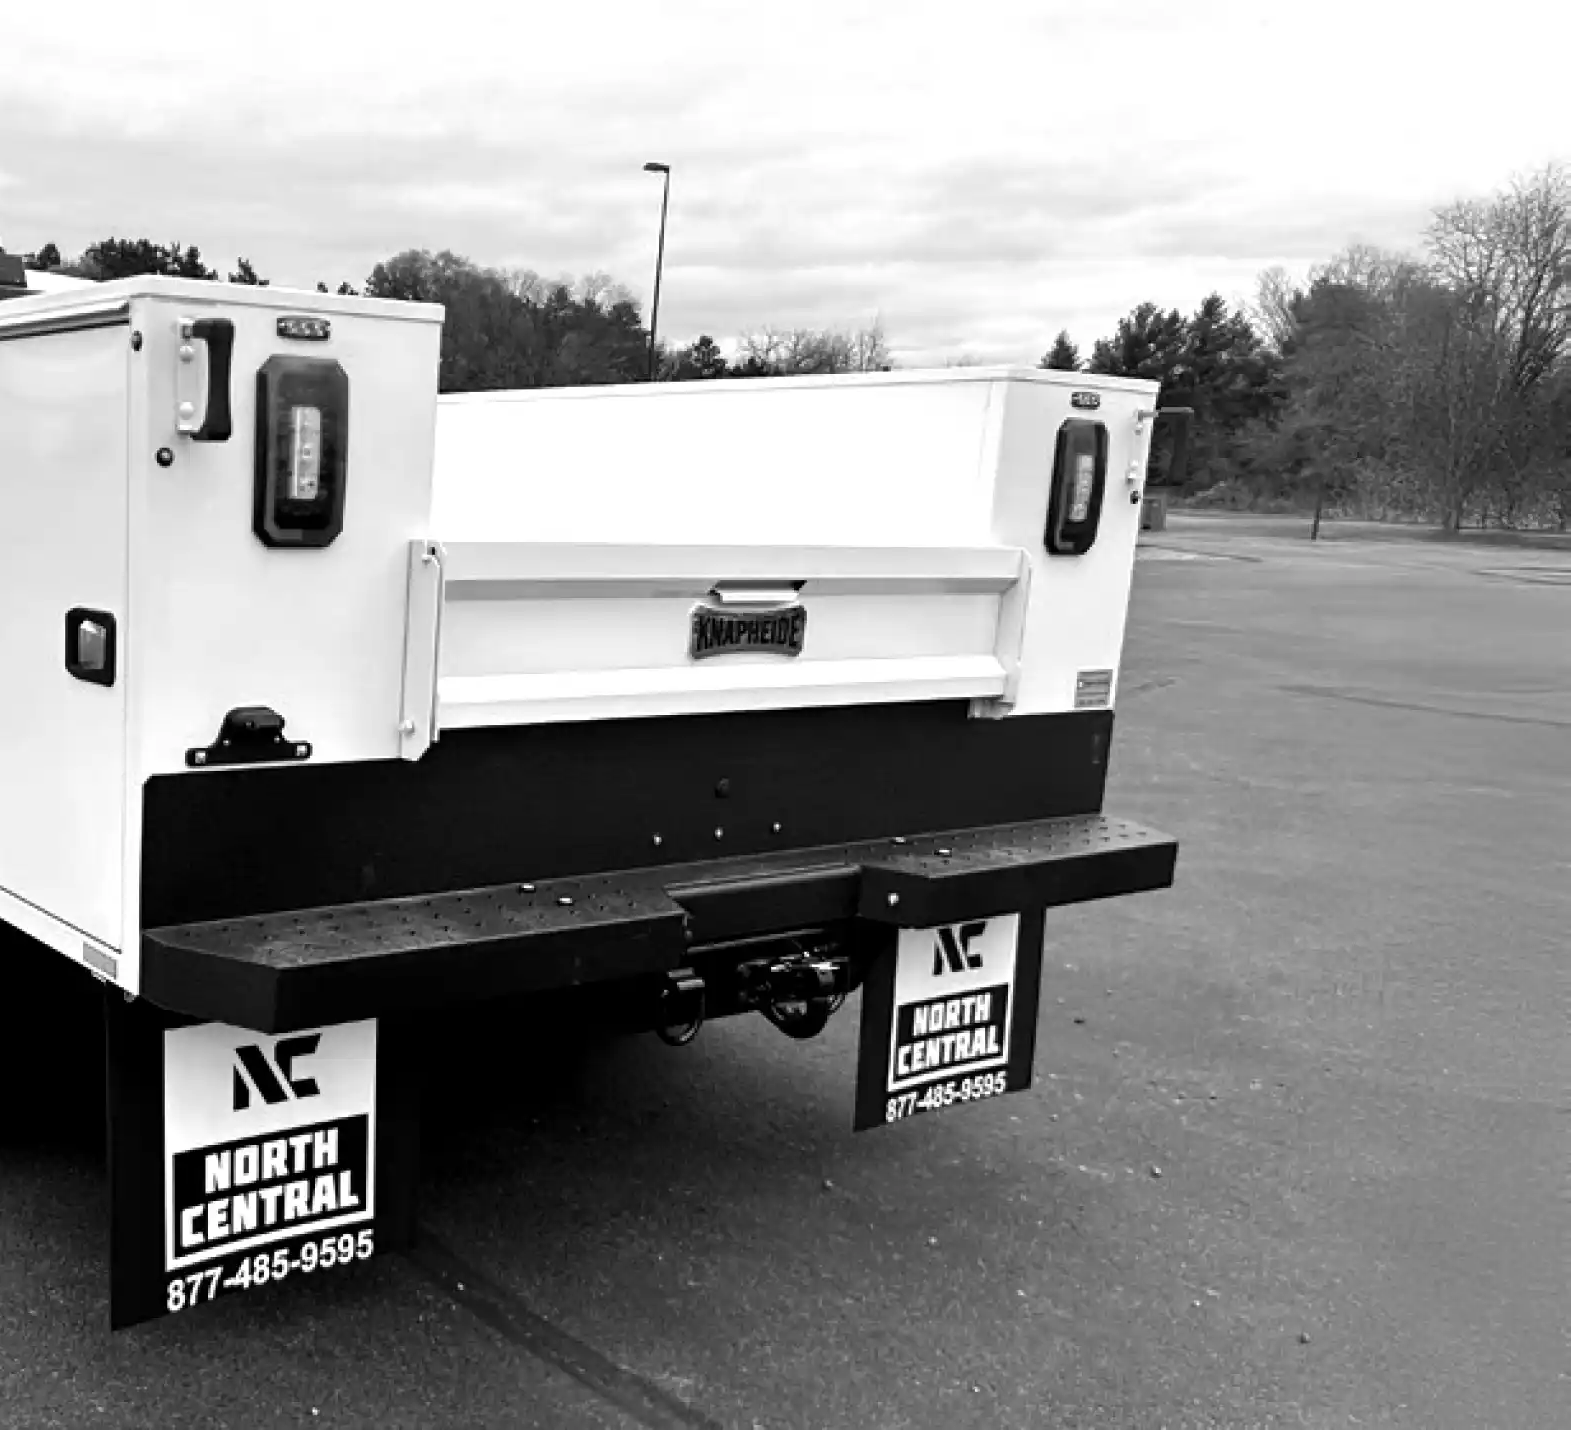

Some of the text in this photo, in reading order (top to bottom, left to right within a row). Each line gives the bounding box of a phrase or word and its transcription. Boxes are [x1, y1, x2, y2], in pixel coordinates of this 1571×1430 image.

[695, 613, 800, 652] KNAPHEIDE
[913, 992, 991, 1037] NORTH
[898, 1025, 1000, 1076] CENTRAL
[886, 1070, 1007, 1123] 877-485-9595
[204, 1127, 339, 1194] NORTH
[181, 1169, 359, 1248] CENTRAL
[166, 1229, 375, 1312] 877-485-9595
